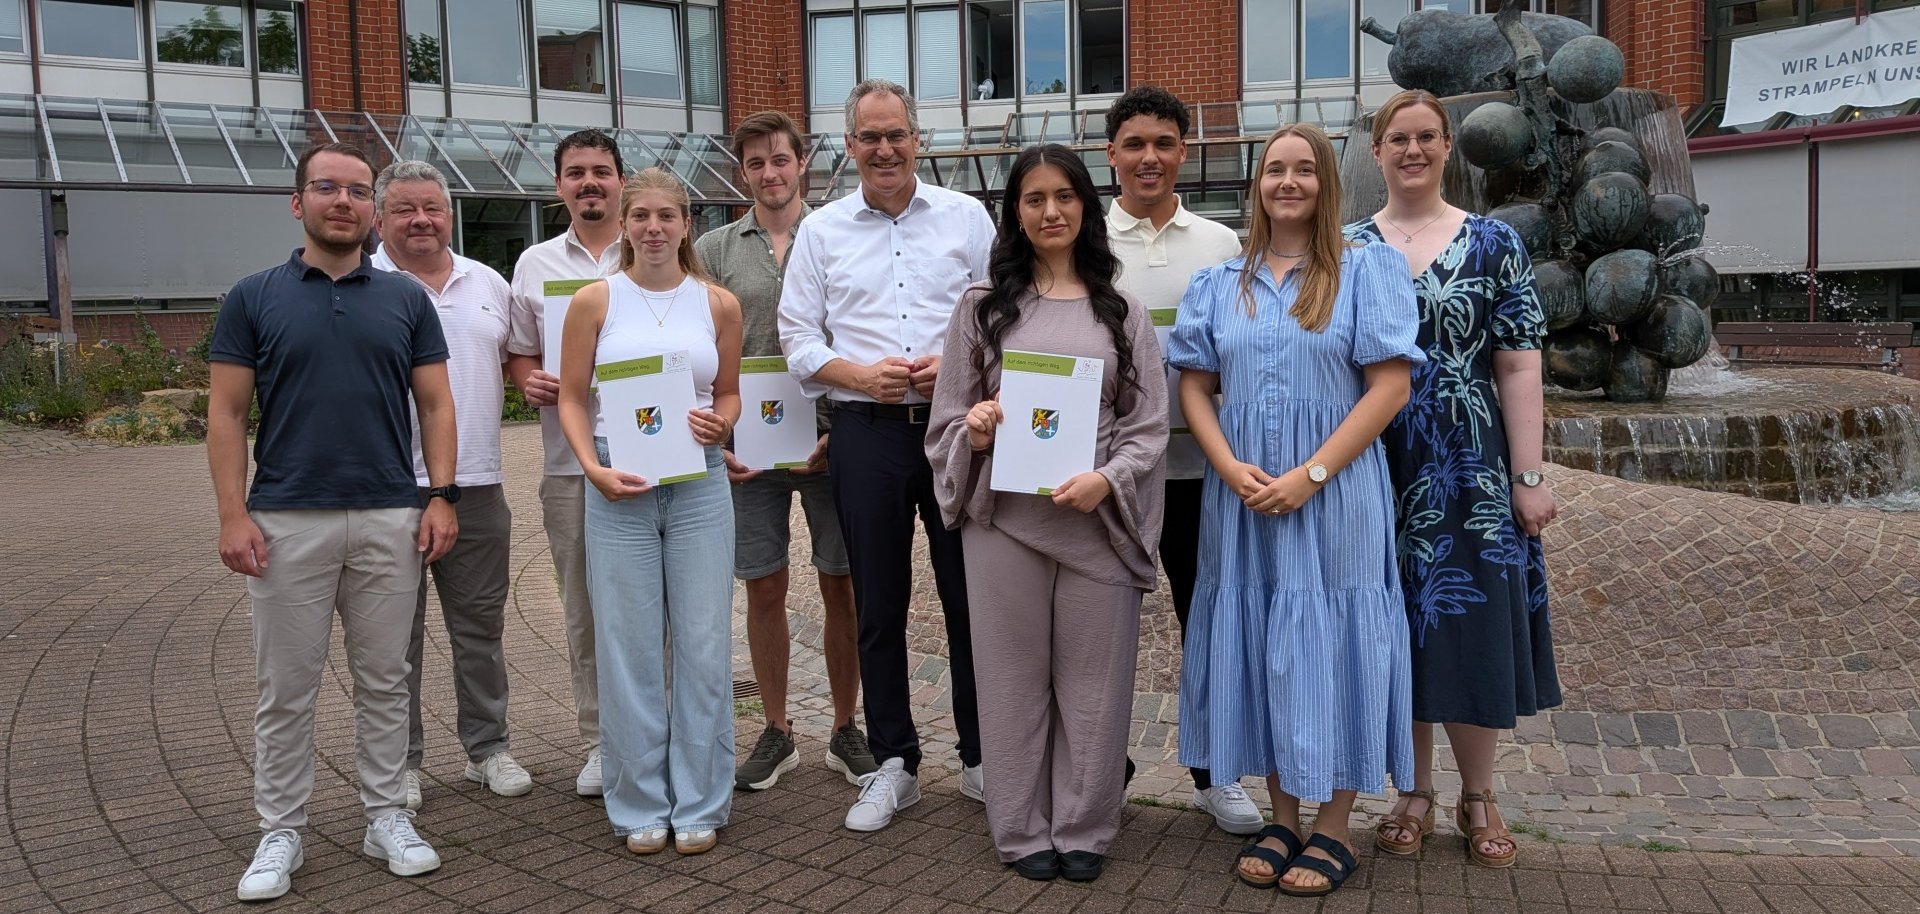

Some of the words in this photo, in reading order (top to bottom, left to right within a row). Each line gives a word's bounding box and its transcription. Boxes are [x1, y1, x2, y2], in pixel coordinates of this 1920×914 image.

[1782, 57, 1818, 76] WIR
[1825, 40, 1918, 69] LANDKRE
[1758, 69, 1877, 102] STRAMPELN
